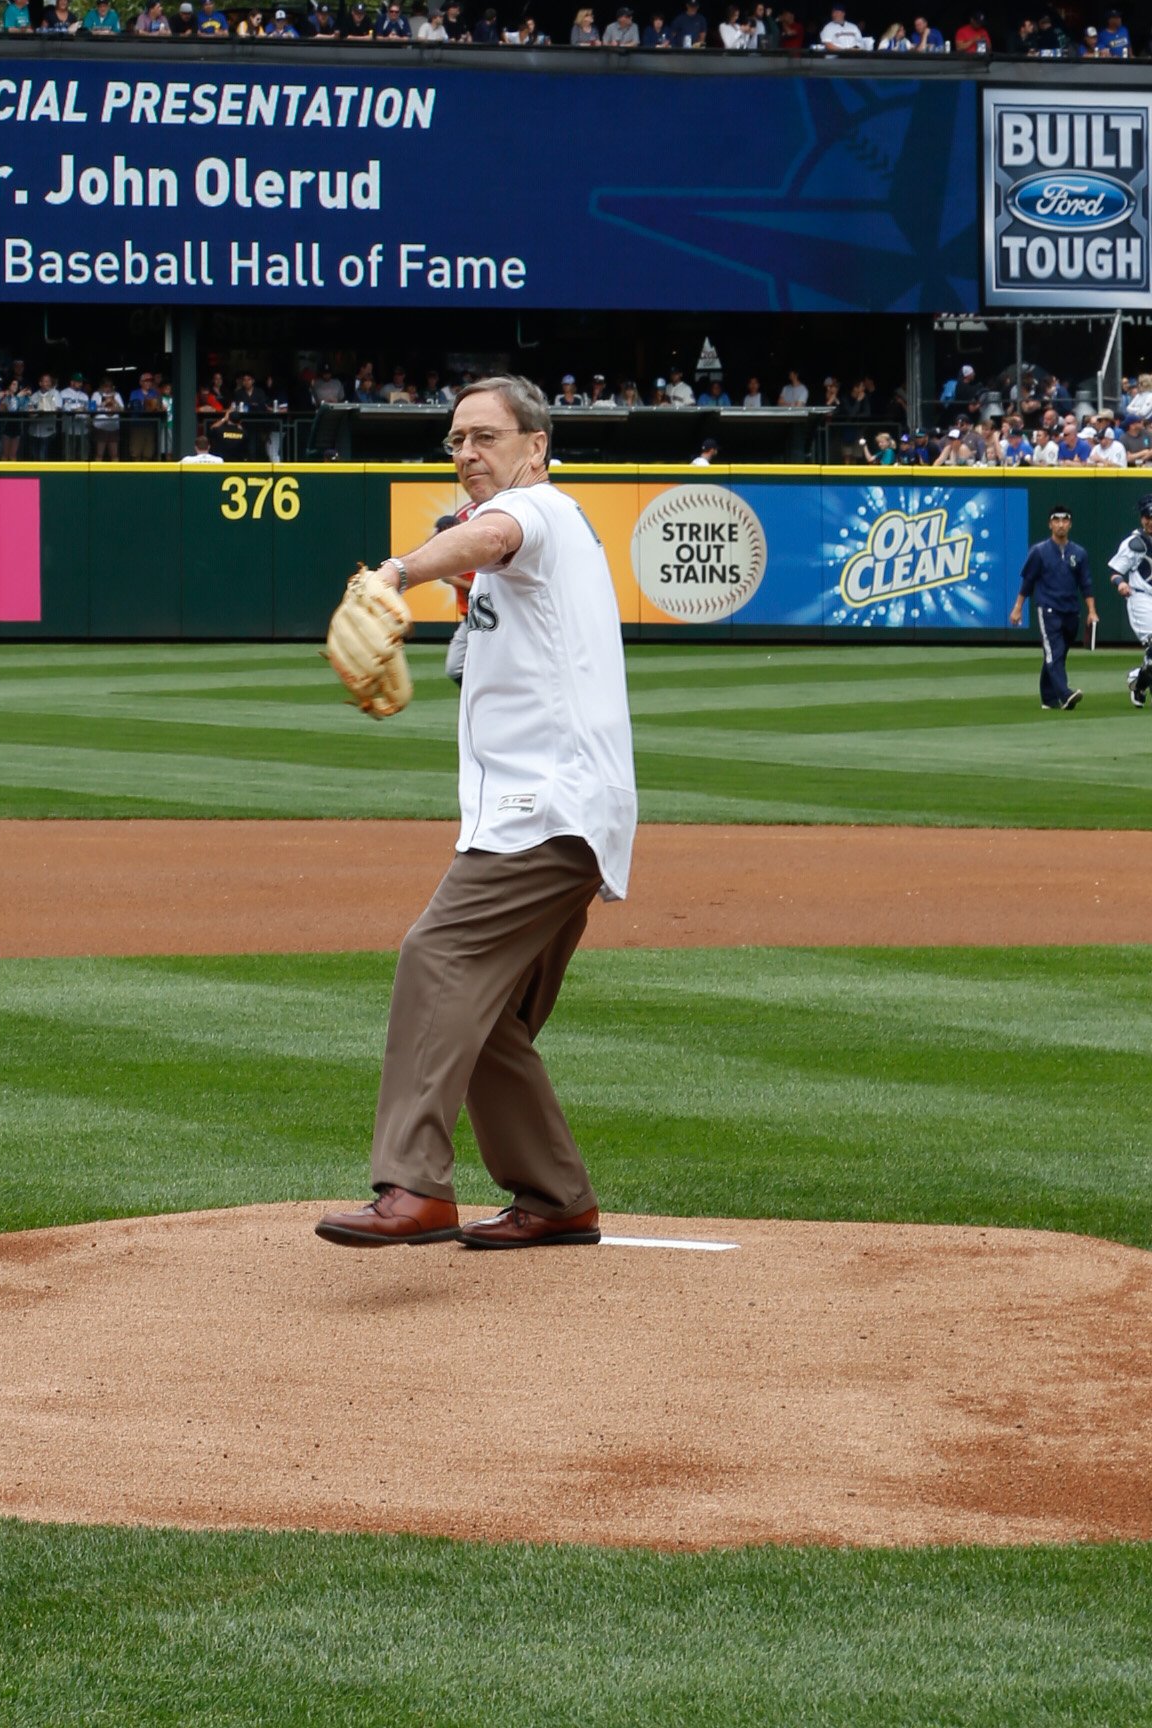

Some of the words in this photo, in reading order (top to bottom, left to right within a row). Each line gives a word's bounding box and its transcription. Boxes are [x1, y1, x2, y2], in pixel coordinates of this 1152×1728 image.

[101, 81, 436, 129] PRESENTATION
[1002, 113, 1142, 168] BUILT
[44, 154, 178, 207] John
[194, 157, 382, 210] Olerud
[1035, 183, 1106, 216] Ford
[5, 238, 212, 286] Baseball
[230, 241, 324, 287] Hall
[339, 243, 382, 288] of
[399, 244, 527, 290] Fame
[1001, 235, 1142, 280] TOUGH
[220, 476, 301, 520] 376
[662, 523, 739, 543] STRIKE
[675, 544, 724, 563] OUT
[870, 512, 943, 560] OXI
[660, 564, 741, 584] STAINS
[845, 537, 969, 601] CLEAN
